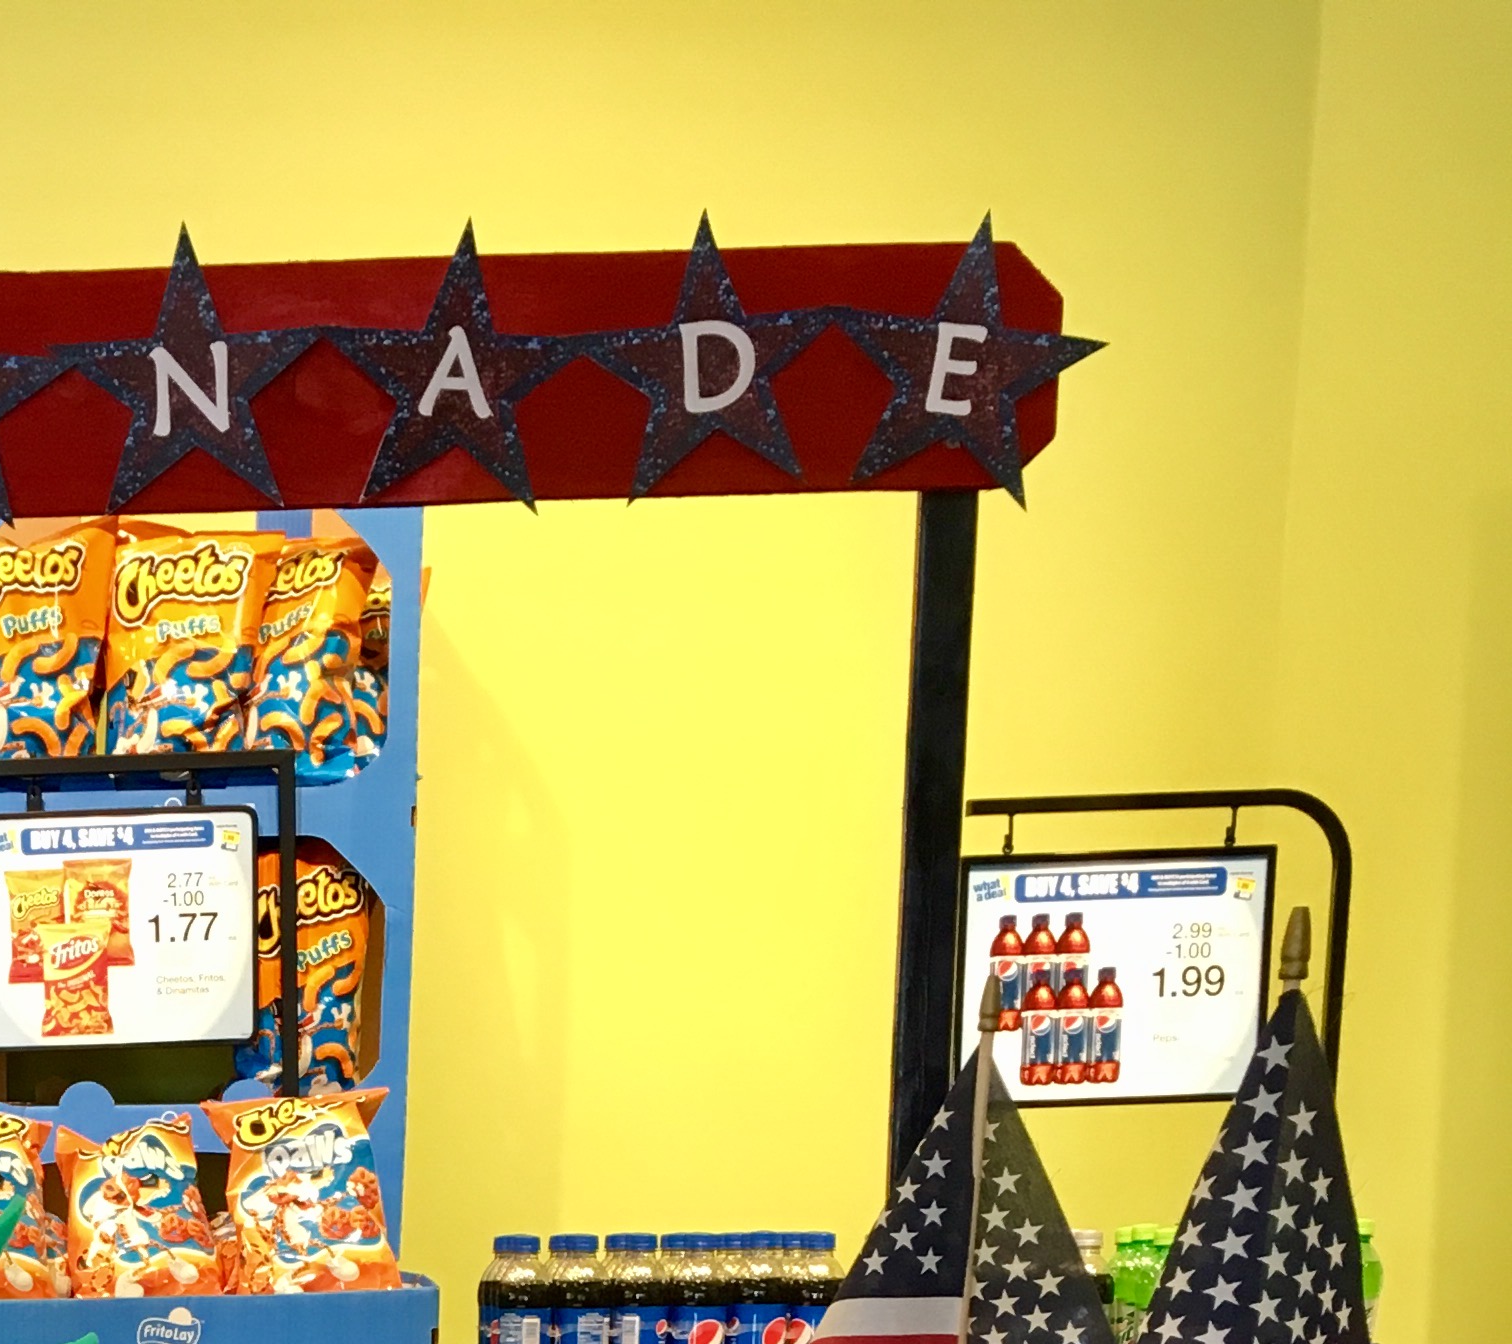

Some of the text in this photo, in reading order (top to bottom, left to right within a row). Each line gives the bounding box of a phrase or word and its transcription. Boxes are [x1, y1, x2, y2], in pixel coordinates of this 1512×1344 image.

[117, 547, 249, 622] Cheetos
[2, 607, 63, 638] Puffs
[259, 602, 313, 644] Puffs
[30, 829, 61, 850] BUY
[62, 829, 77, 849] 4,
[78, 827, 116, 848] SAVE
[117, 826, 135, 846] $4
[167, 871, 204, 889] 2.77
[973, 878, 1001, 893] what
[1025, 875, 1058, 897] BUY
[1060, 875, 1076, 897] 4,
[1078, 873, 1120, 896] SAVE
[1121, 872, 1140, 894] $4
[163, 890, 205, 907] -1.00
[148, 912, 219, 943] 1.77
[1172, 922, 1213, 939] 2.99
[49, 937, 100, 970] Fritos
[1166, 942, 1212, 958] -1.00
[166, 986, 210, 994] Dinamitas
[1152, 965, 1226, 997] 1.99
